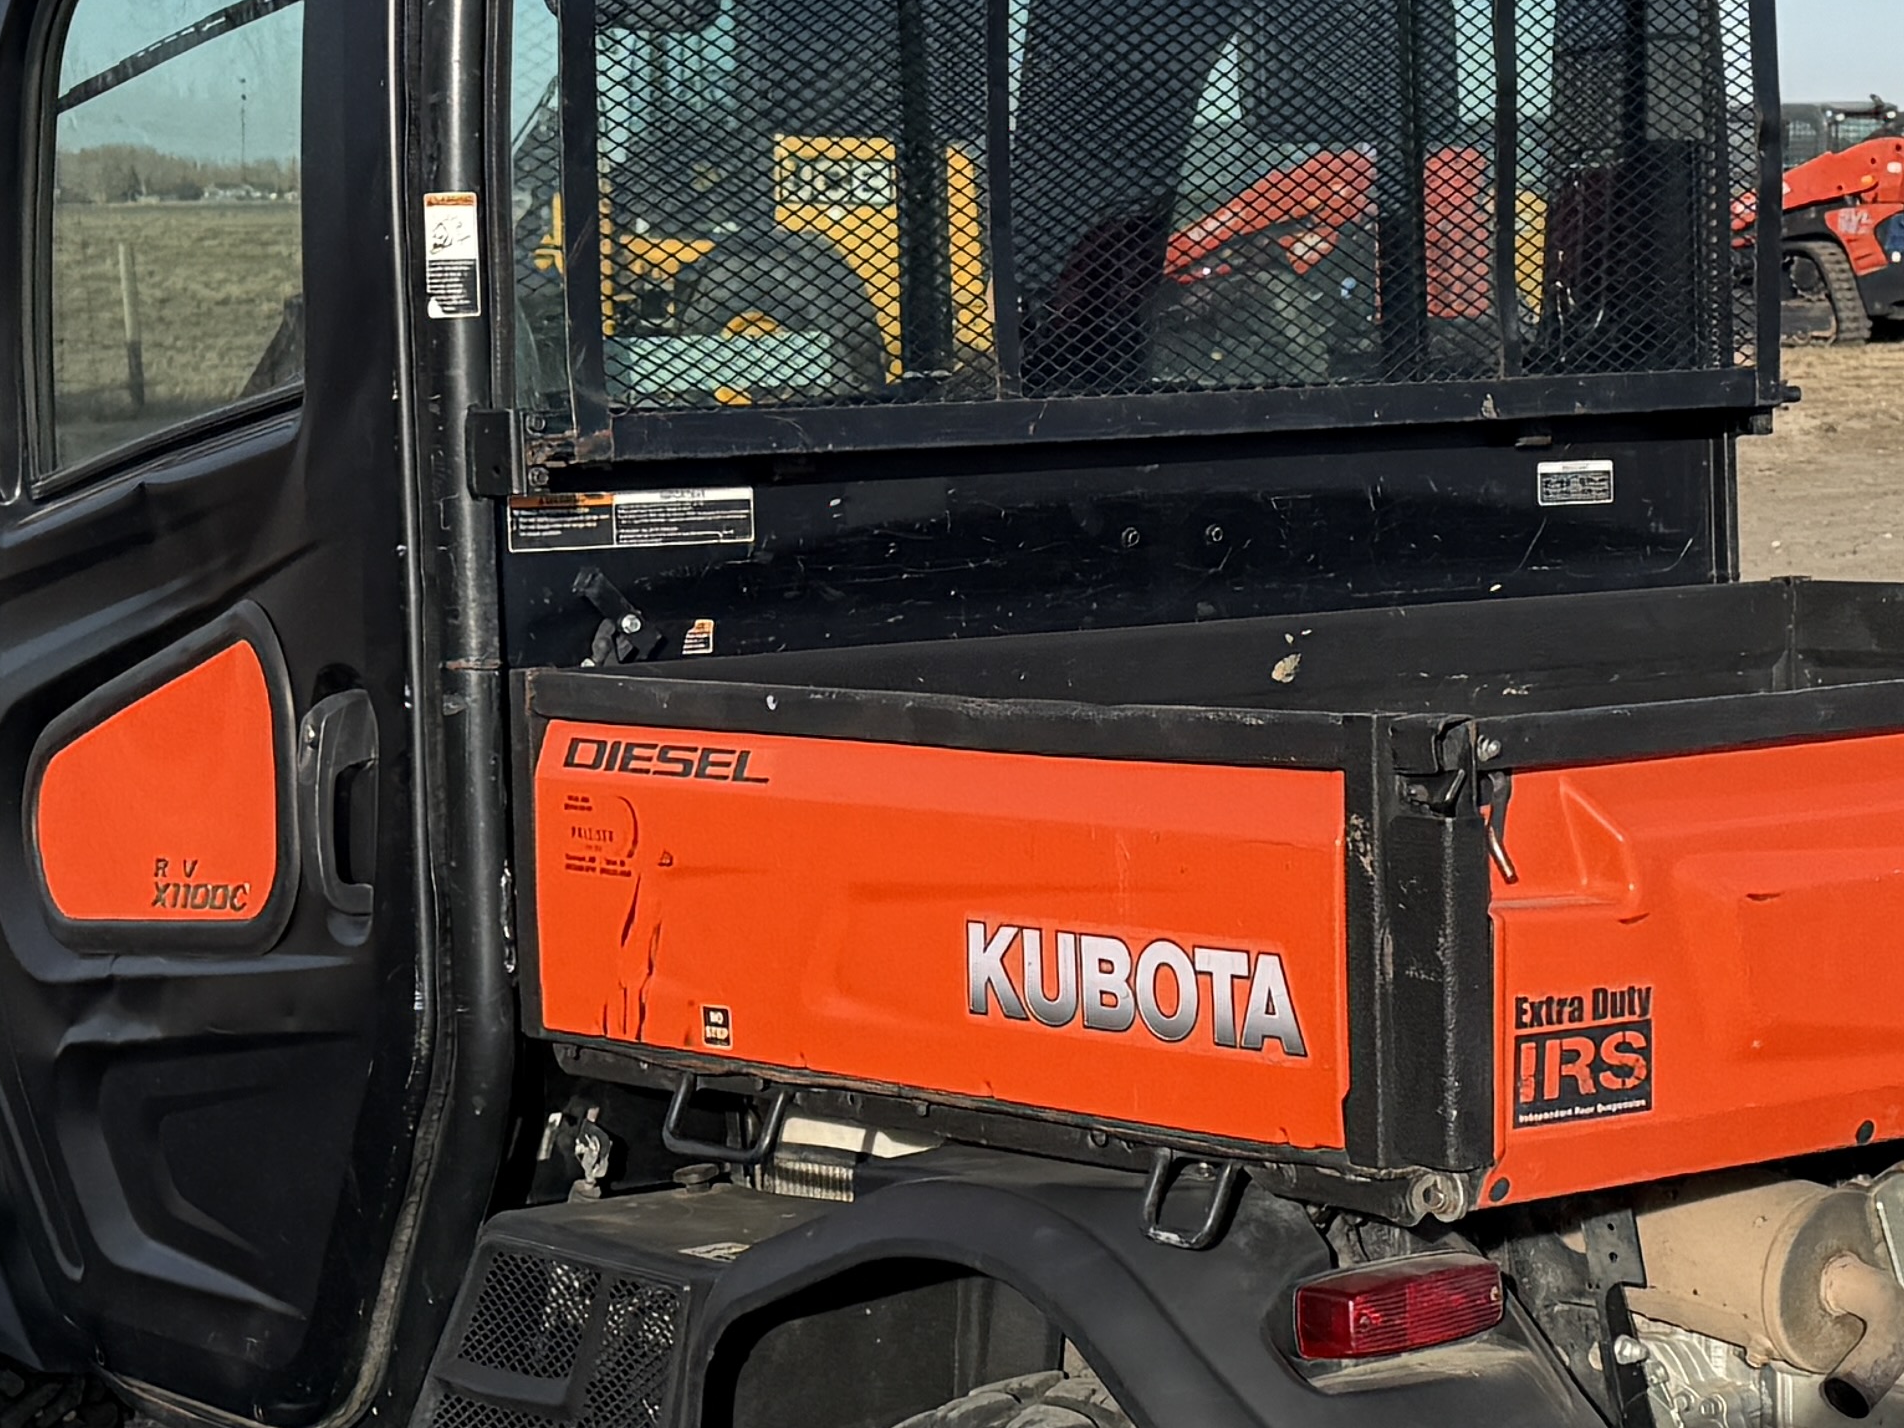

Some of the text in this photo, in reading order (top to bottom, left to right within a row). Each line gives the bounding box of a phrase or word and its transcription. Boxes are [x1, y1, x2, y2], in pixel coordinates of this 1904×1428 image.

[563, 736, 770, 784] DIESEL
[966, 919, 1309, 1058] KUBOTA
[1514, 985, 1653, 1030] Extra Duty
[1519, 1030, 1648, 1104] IRS
